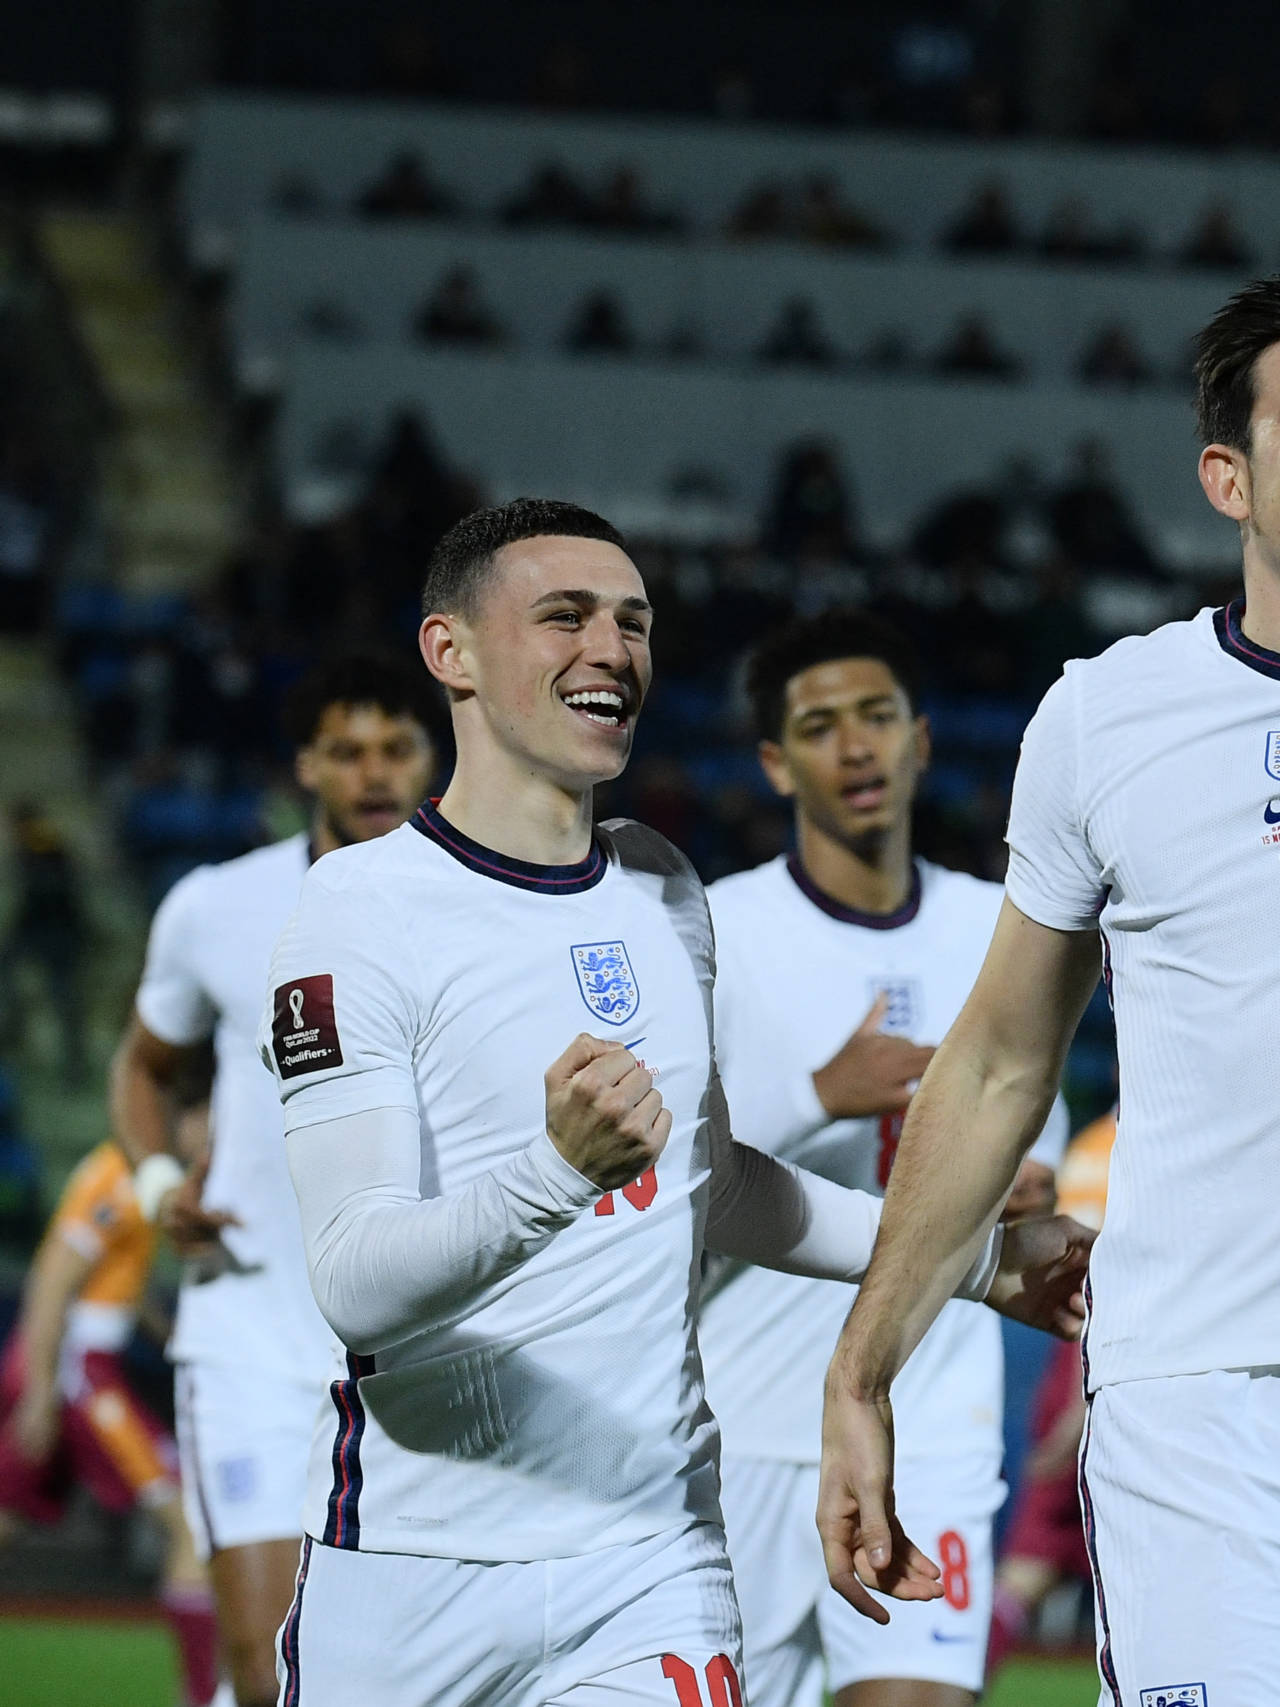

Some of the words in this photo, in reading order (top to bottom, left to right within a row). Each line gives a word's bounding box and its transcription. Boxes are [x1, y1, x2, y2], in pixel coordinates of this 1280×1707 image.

[1261, 835, 1271, 845] 15
[284, 1048, 328, 1067] Qualifiers
[938, 1530, 970, 1611] 8
